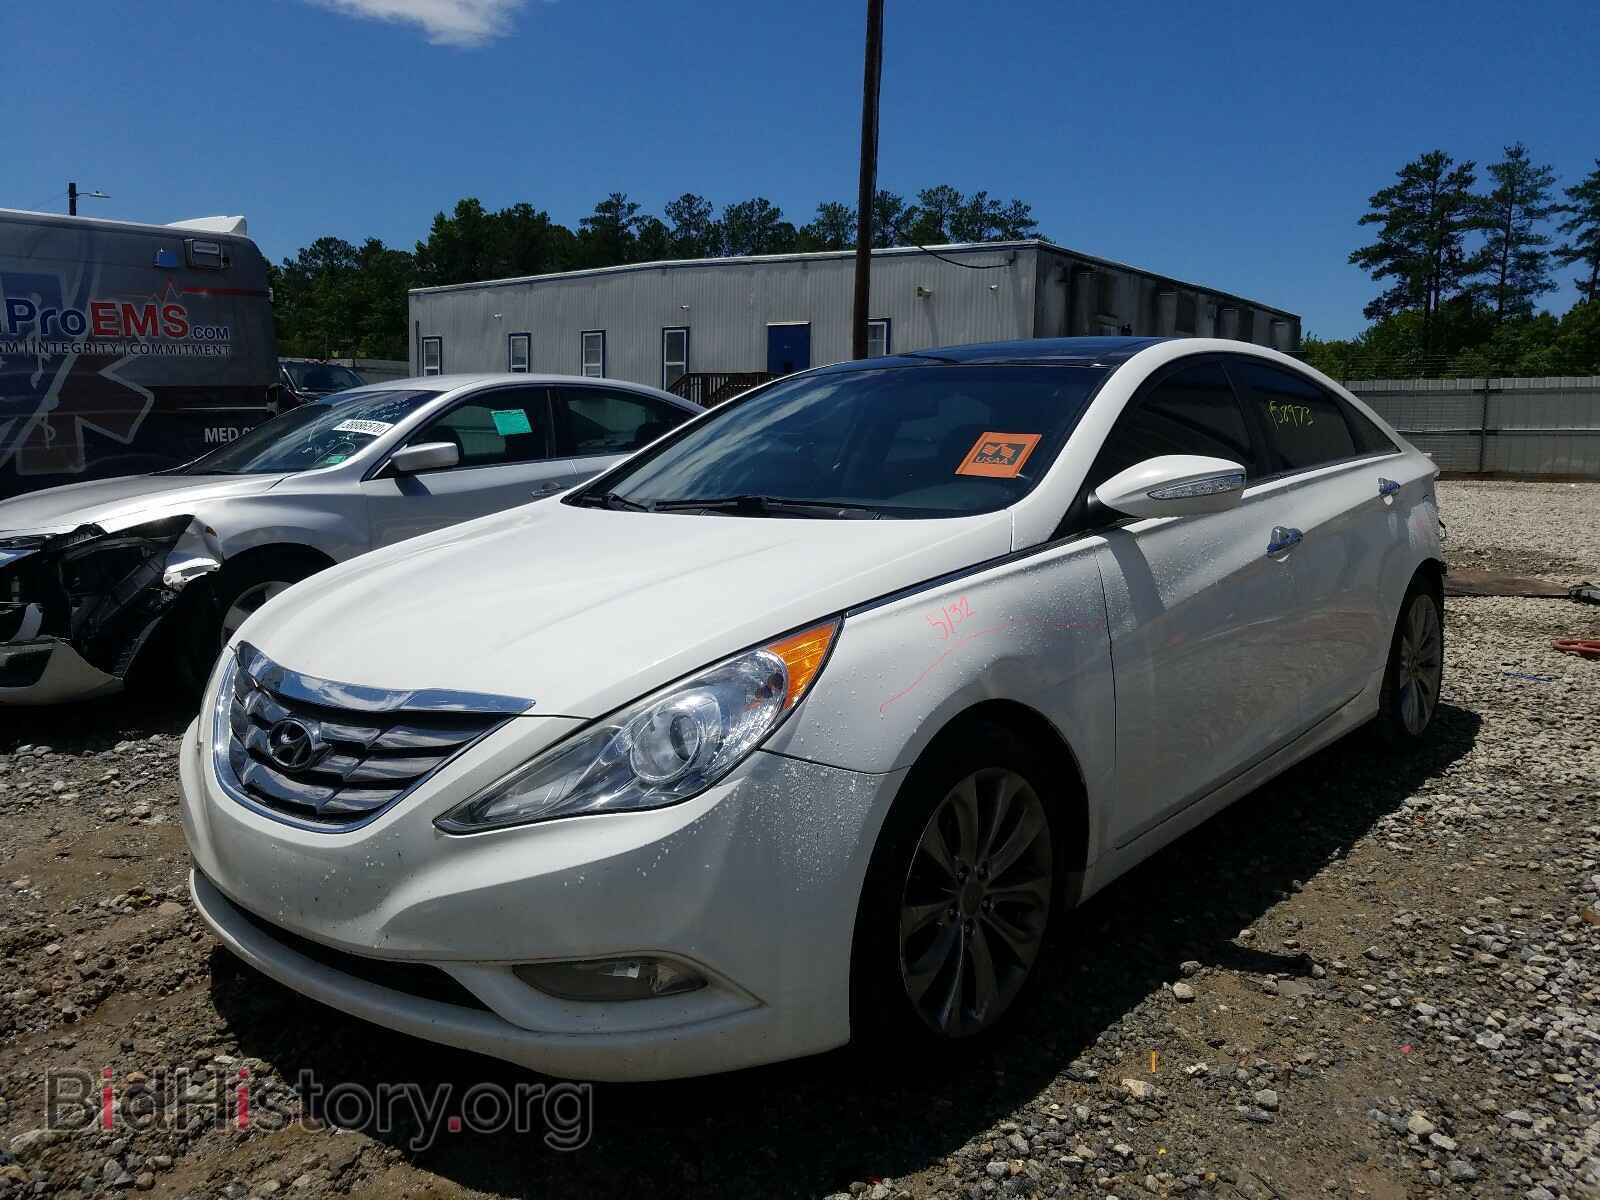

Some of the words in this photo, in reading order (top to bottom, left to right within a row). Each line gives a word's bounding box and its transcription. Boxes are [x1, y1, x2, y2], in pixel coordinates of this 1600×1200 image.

[0, 298, 230, 339] ProEMS.COM
[33, 342, 118, 353] INTEGRITY
[130, 343, 231, 356] COMMITMENT
[204, 427, 239, 443] MED
[975, 456, 1008, 465] USAA
